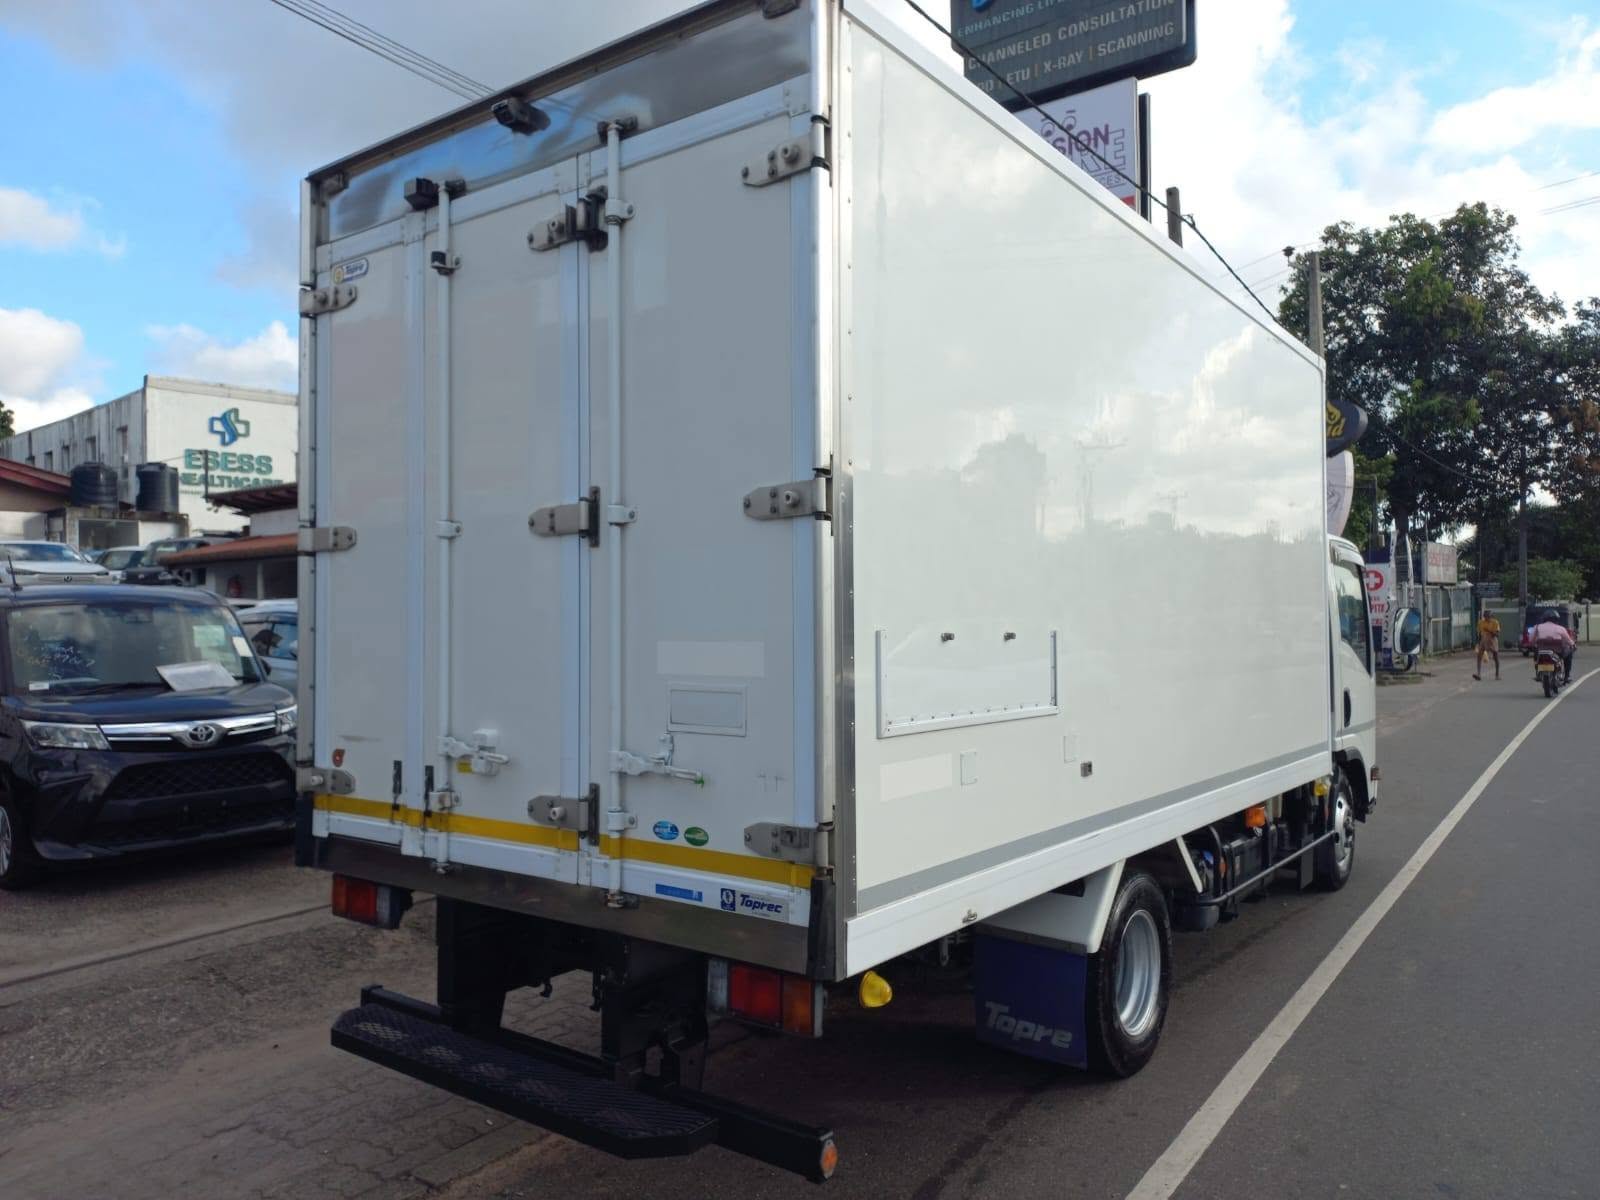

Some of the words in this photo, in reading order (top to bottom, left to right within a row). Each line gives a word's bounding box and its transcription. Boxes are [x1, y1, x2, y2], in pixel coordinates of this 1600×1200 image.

[957, 3, 1034, 37] ENHANCING
[1006, 67, 1030, 85] ETU
[1043, 50, 1083, 73] X-RAY
[1097, 22, 1174, 57] SCANNING
[184, 448, 273, 476] ESESS
[740, 893, 783, 913] Toprec
[985, 1000, 1073, 1049] Topre
